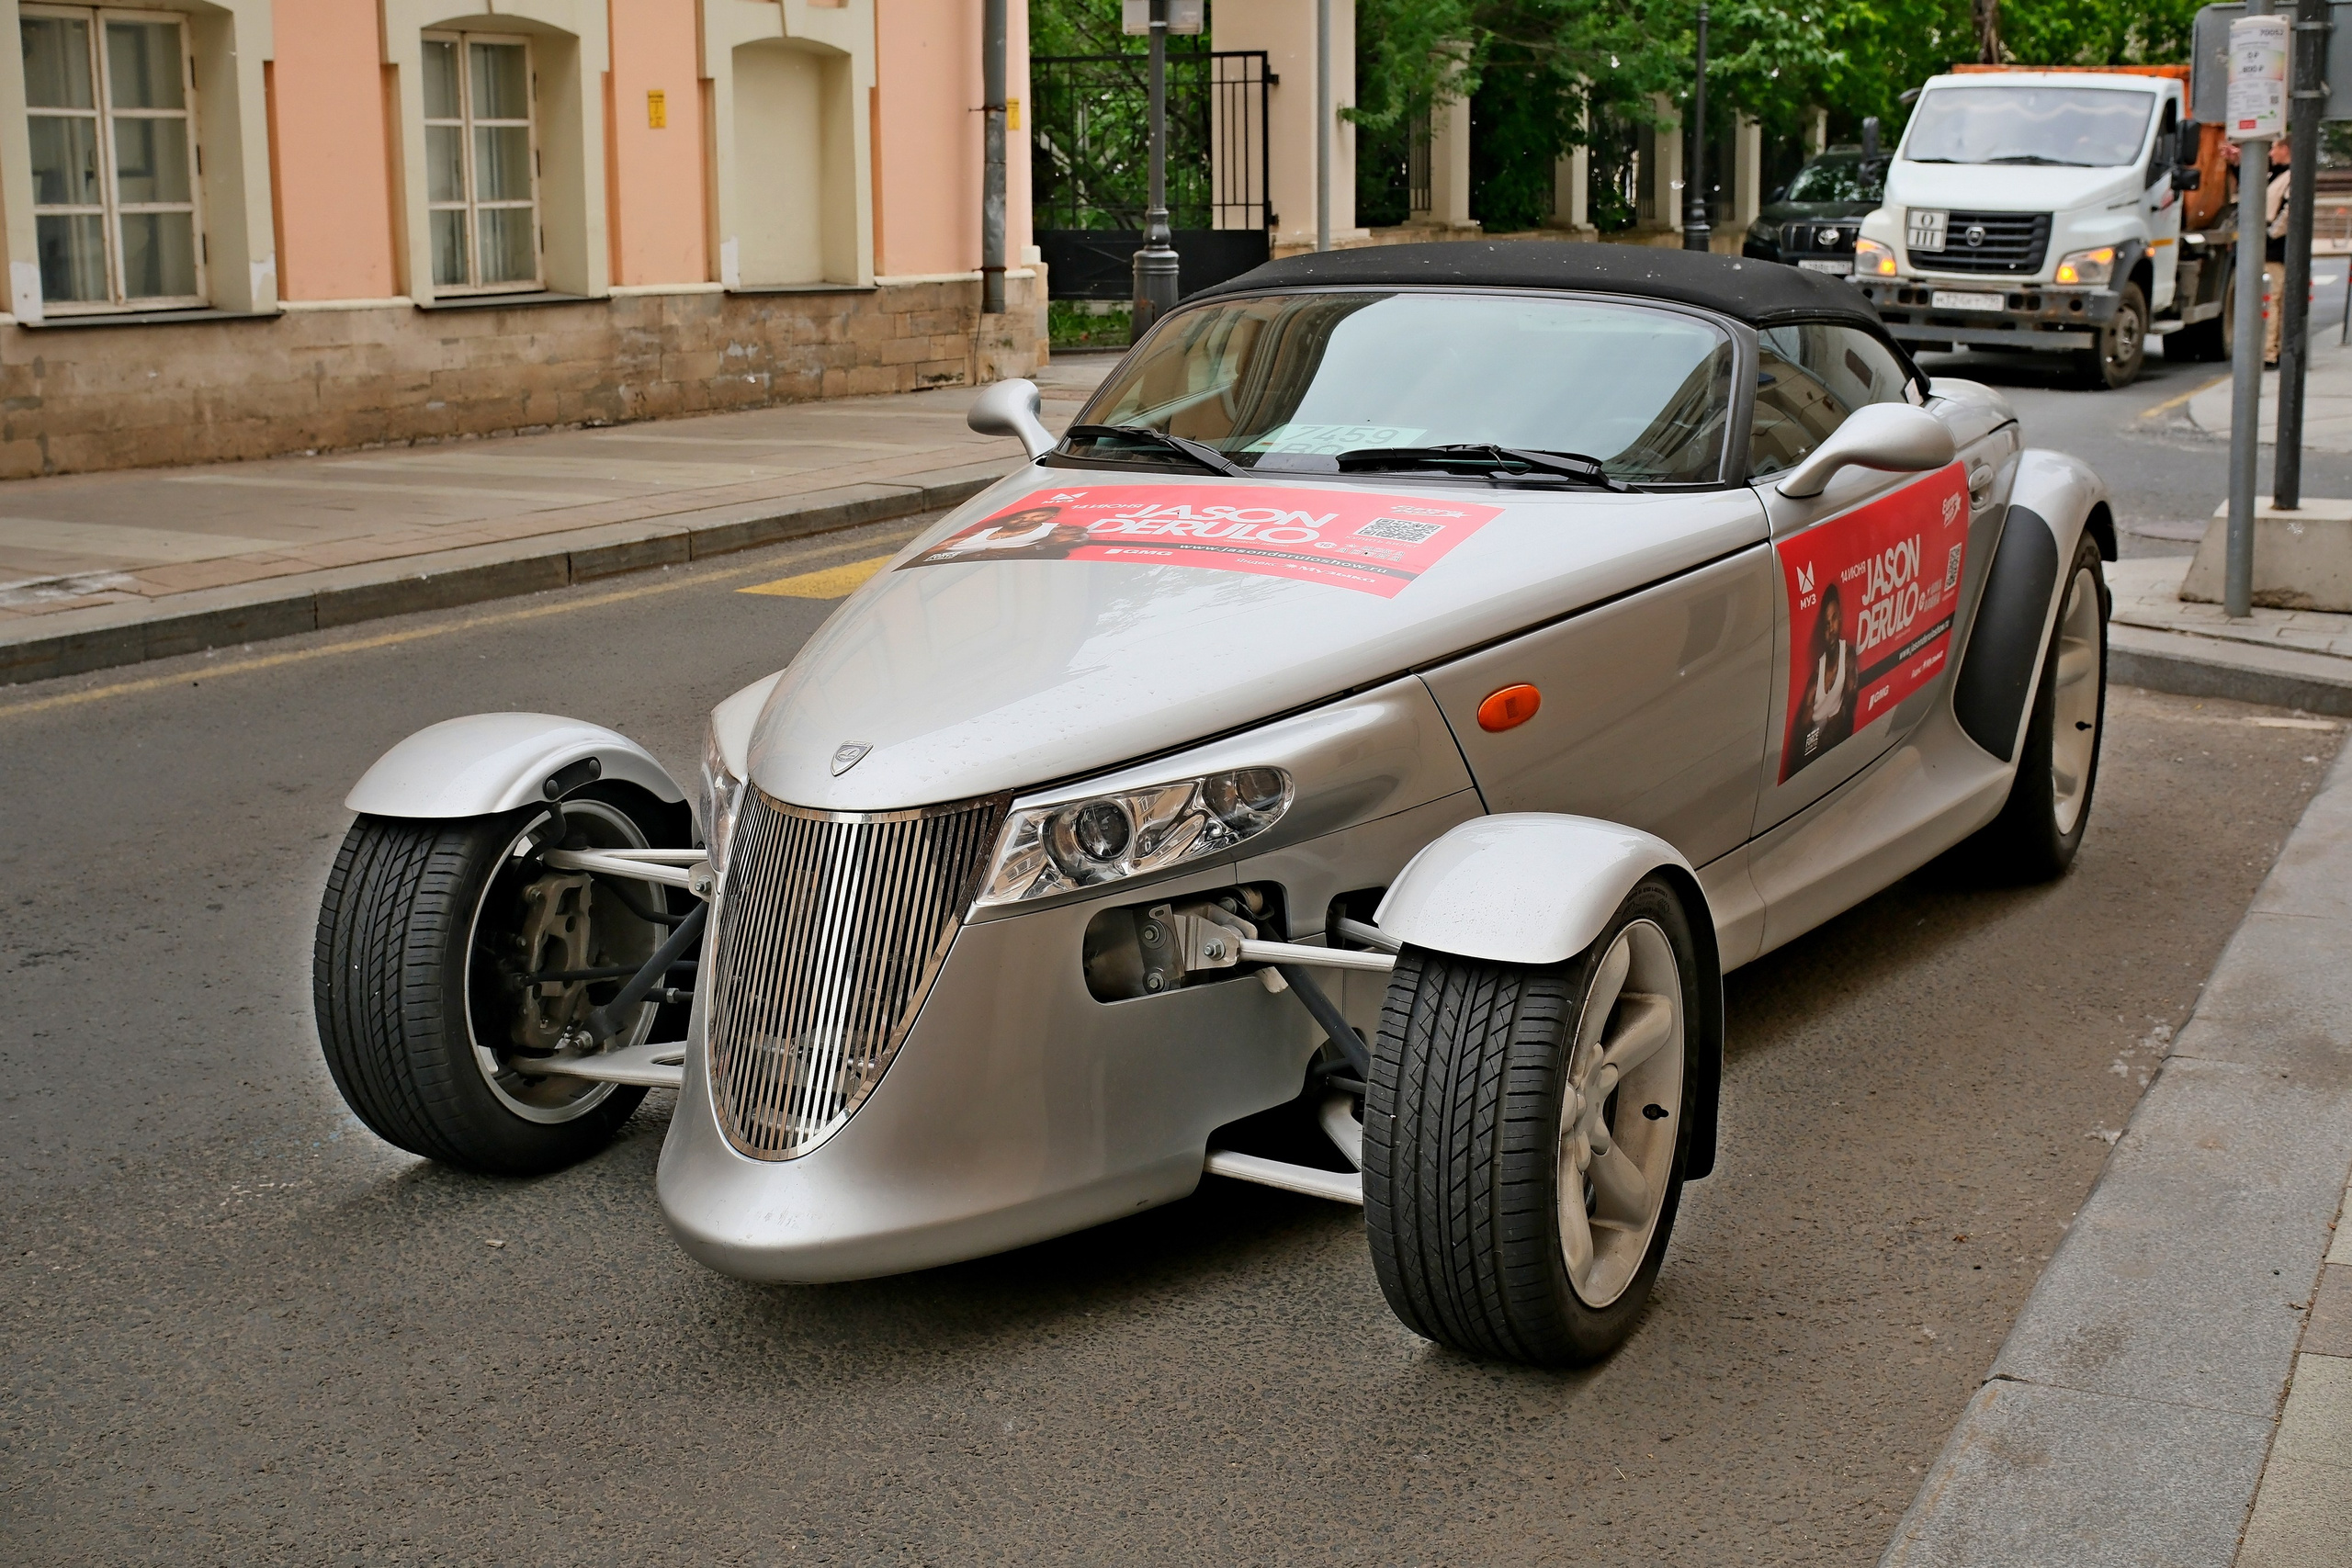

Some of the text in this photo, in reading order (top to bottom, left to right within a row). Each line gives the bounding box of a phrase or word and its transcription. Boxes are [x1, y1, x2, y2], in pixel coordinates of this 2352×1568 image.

[1284, 425, 1400, 445] 7459
[1115, 504, 1340, 528] JASON
[1087, 518, 1320, 544] DERULO
[1180, 544, 1387, 574] www.jasonderuloshow.ru
[1235, 558, 1376, 583] Яндекс Музыка
[1840, 560, 1866, 583] 14 ИЮНЯ
[1861, 534, 1920, 606] JASON
[1801, 593, 1816, 610] МУЗ
[1856, 581, 1919, 656] DERULO
